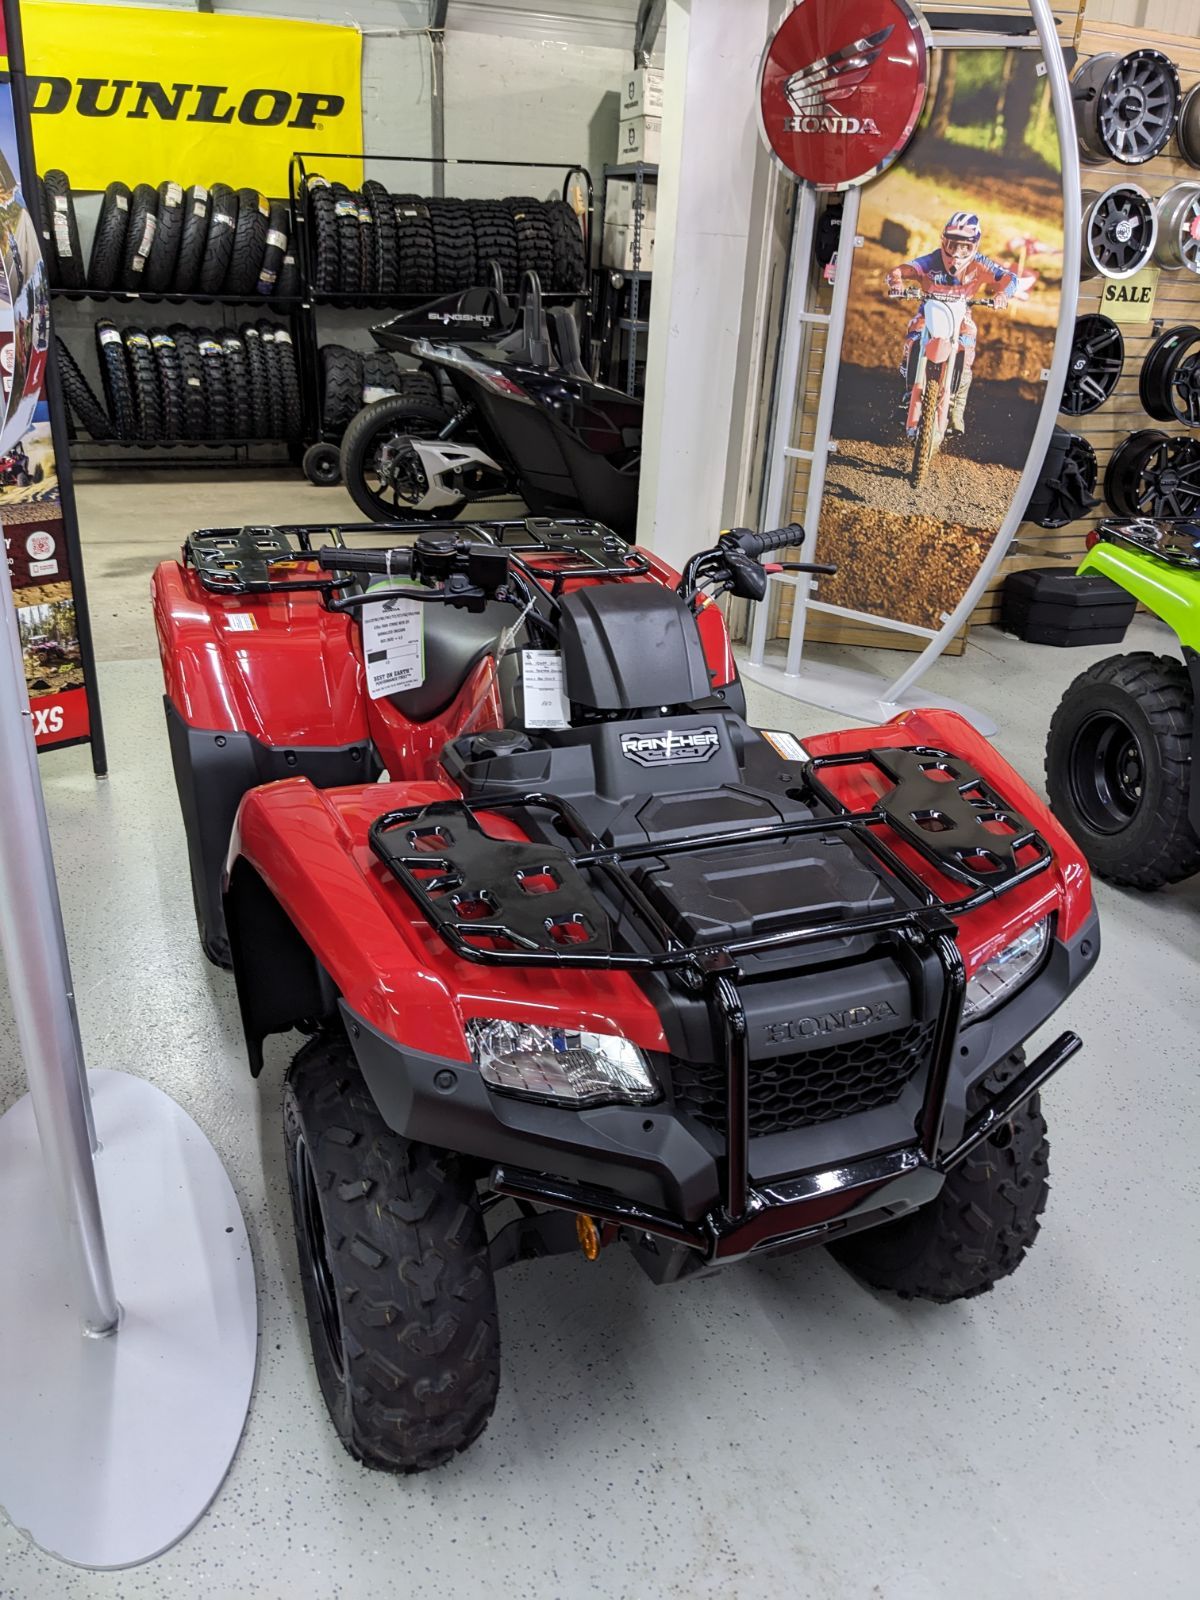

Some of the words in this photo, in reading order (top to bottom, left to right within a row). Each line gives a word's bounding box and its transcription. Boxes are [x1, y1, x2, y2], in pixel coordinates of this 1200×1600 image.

[26, 75, 345, 130] DUNLOP
[783, 116, 881, 136] HONDA
[1105, 284, 1152, 304] SALE
[427, 312, 495, 323] SLINGSHOT
[621, 733, 720, 753] RANCHER
[762, 1000, 900, 1046] HONDA
